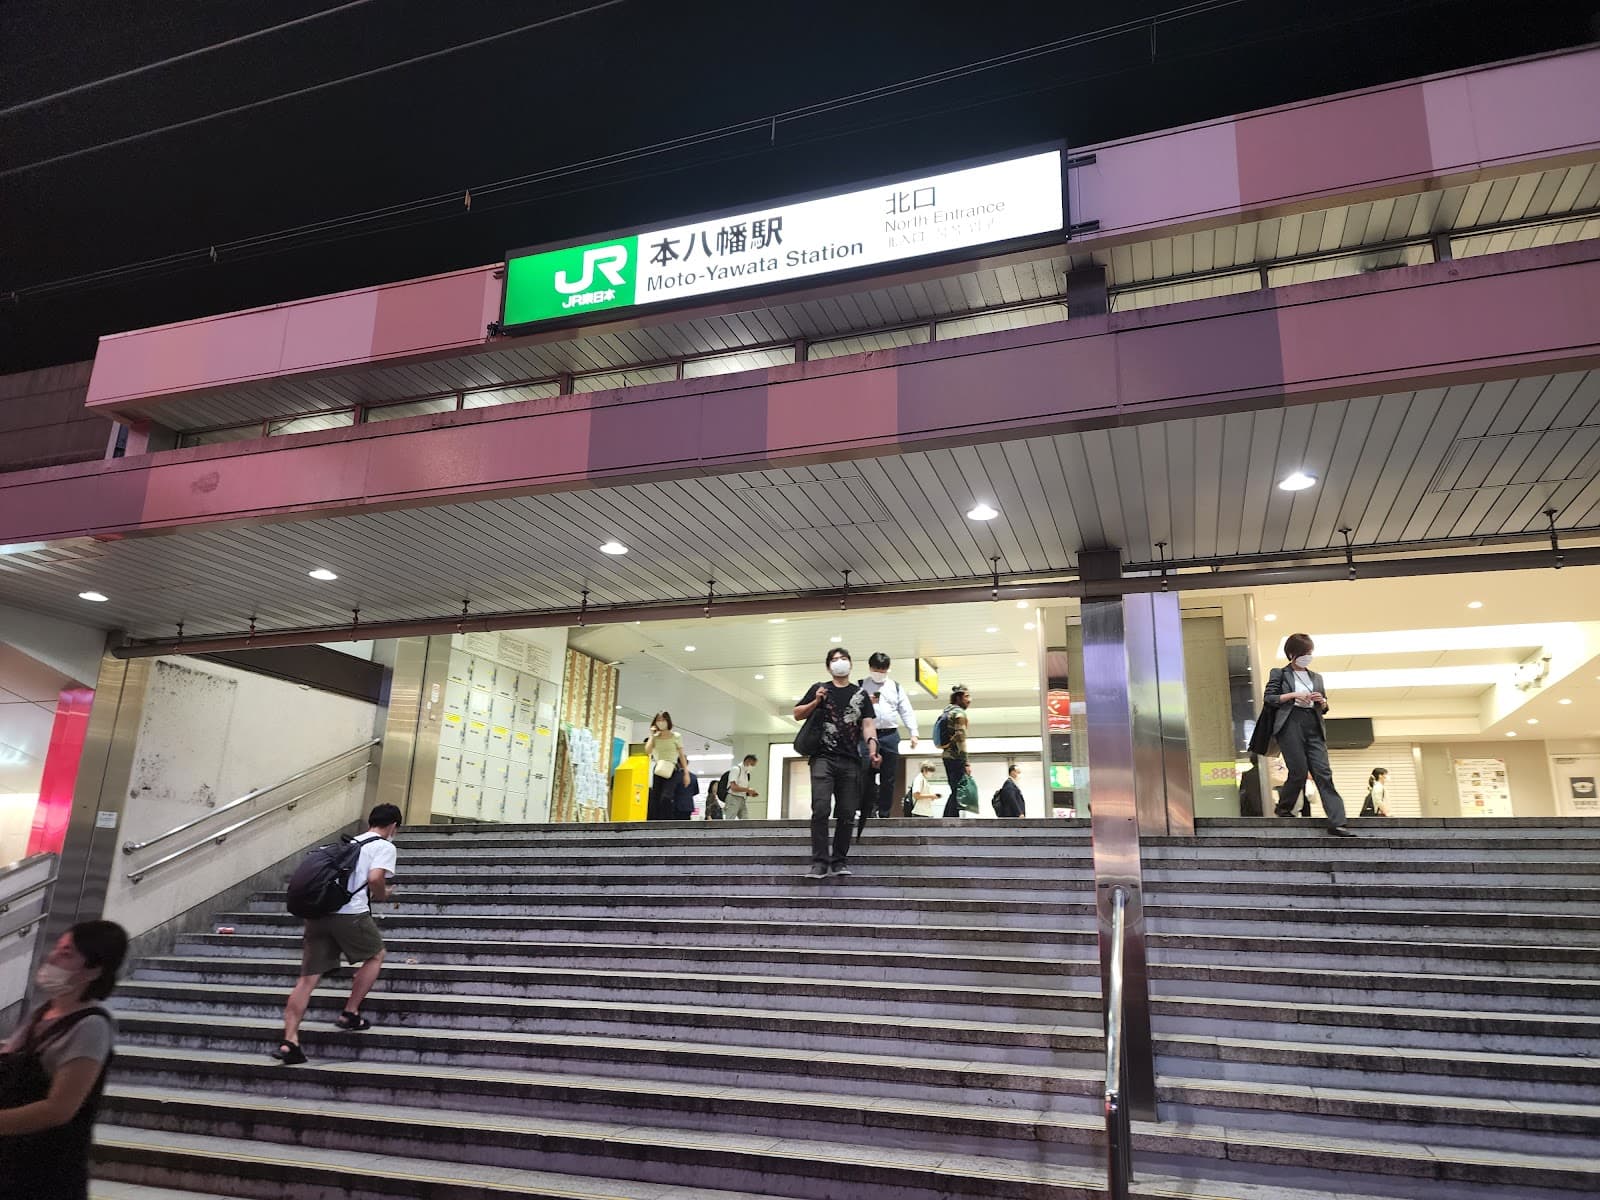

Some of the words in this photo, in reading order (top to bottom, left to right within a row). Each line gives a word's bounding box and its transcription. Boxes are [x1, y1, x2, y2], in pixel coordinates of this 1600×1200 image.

[884, 215, 928, 232] North
[933, 201, 1006, 223] Entrance
[885, 186, 936, 215] 北口
[649, 216, 783, 267] 本八幡駅
[554, 244, 628, 294] JR
[647, 255, 778, 292] Moto-Yawata
[786, 242, 863, 267] Station
[562, 288, 616, 308] JR東日本
